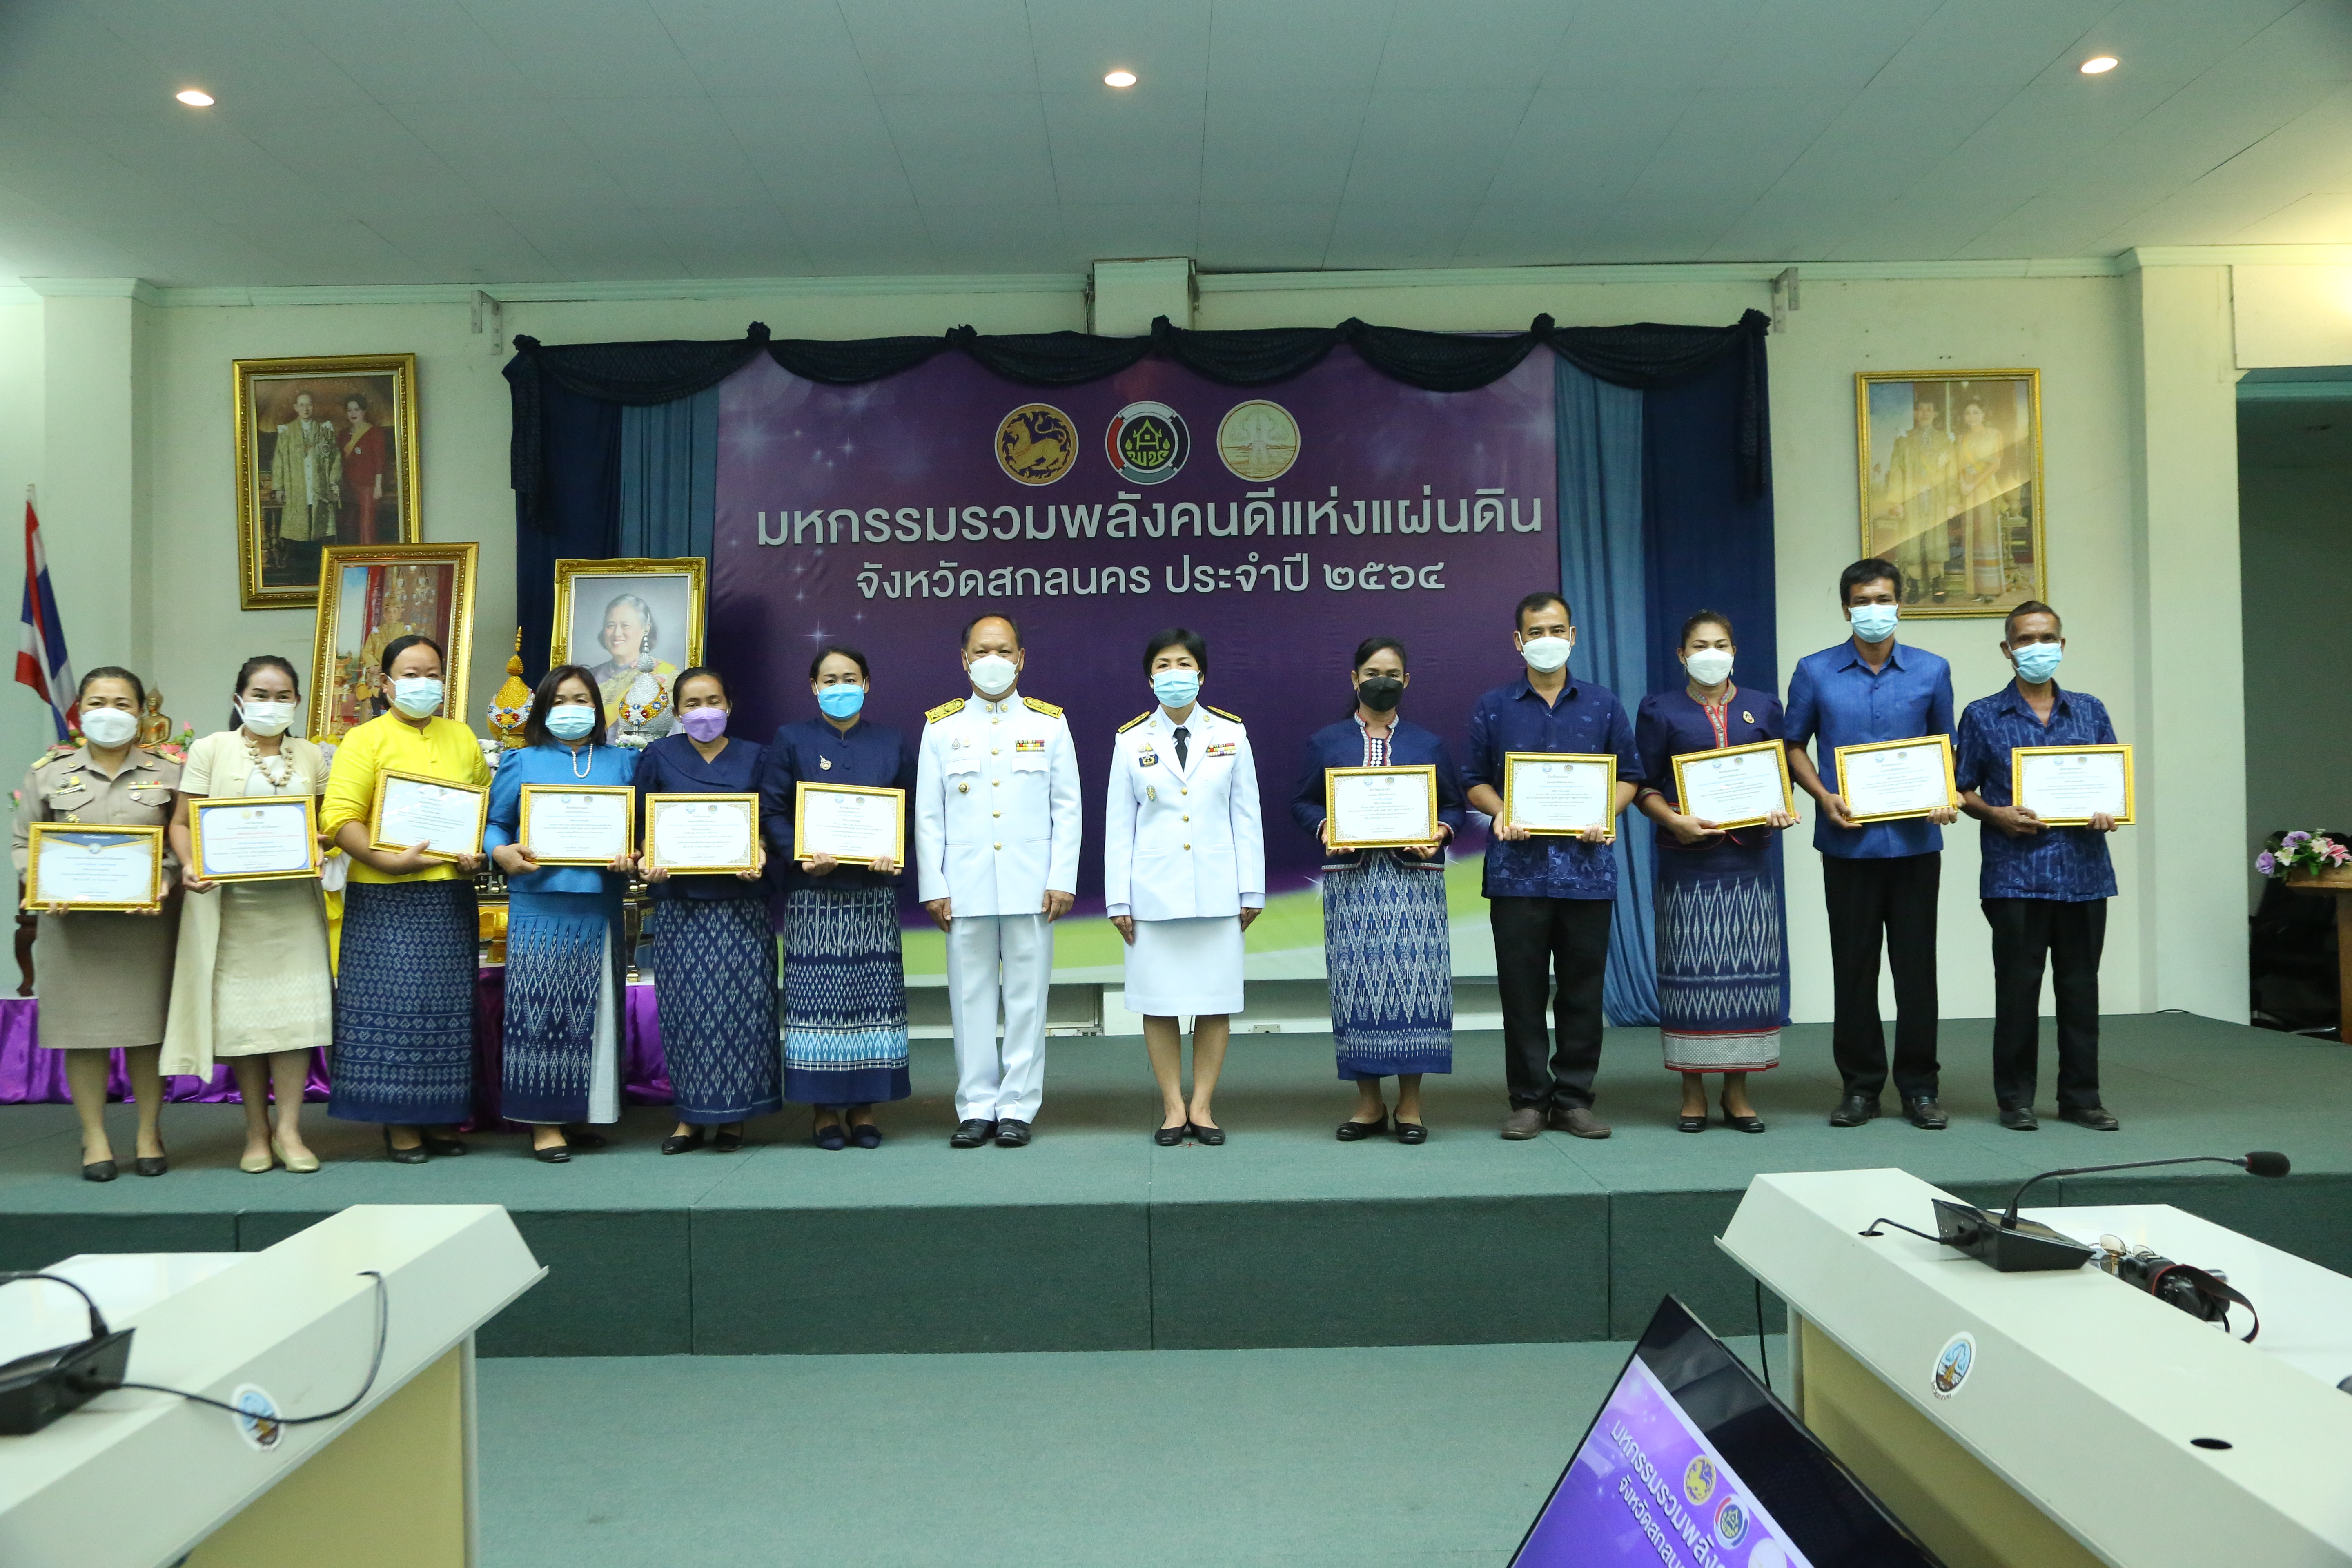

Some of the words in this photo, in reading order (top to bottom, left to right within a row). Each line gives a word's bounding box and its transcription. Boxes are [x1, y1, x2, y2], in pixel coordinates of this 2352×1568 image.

[758, 485, 1541, 545] มหกรรมรวมพลังคนดีแห่งแผ่นดิน
[856, 560, 1151, 598] จังหวัดสกลนคร
[1166, 552, 1309, 593] ประจำปี
[1323, 561, 1445, 590] ๒๕๖๔
[1611, 1419, 1726, 1568] มหกรรมรวมพลัง
[1619, 1474, 1686, 1568] จังหวัดสกลน
